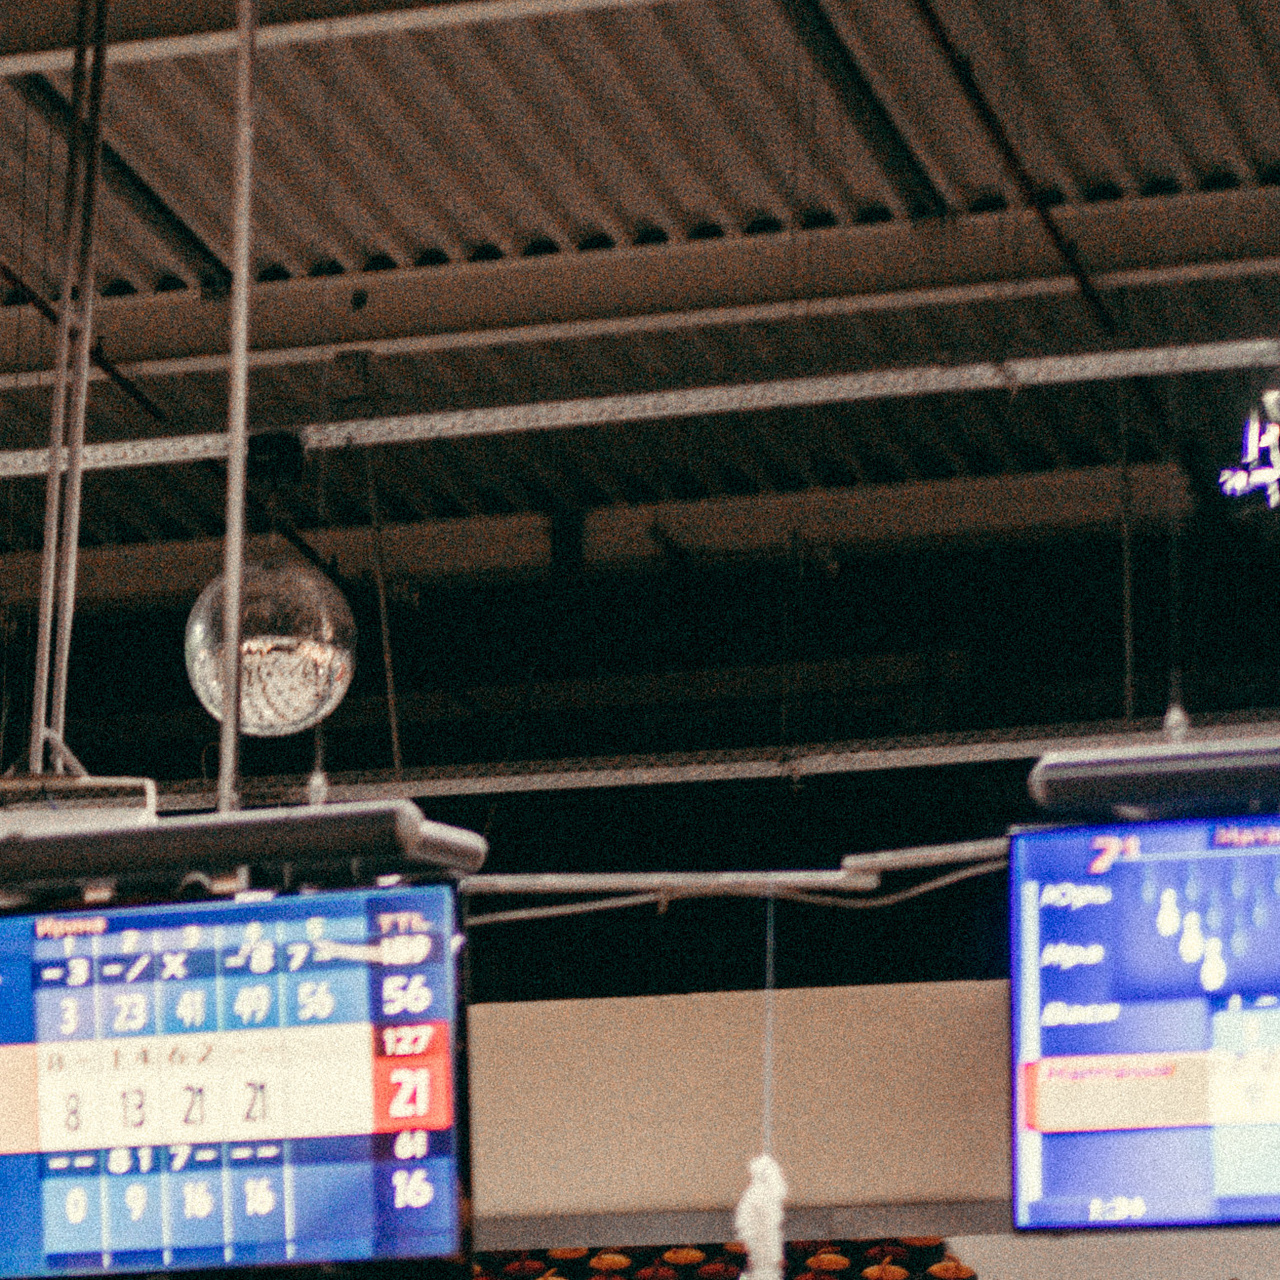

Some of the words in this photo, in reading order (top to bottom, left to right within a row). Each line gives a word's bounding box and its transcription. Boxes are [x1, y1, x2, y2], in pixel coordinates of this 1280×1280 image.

[381, 974, 433, 1015] 56
[383, 1024, 434, 1057] 127
[389, 1067, 431, 1119] 21
[392, 1168, 434, 1209] 16
